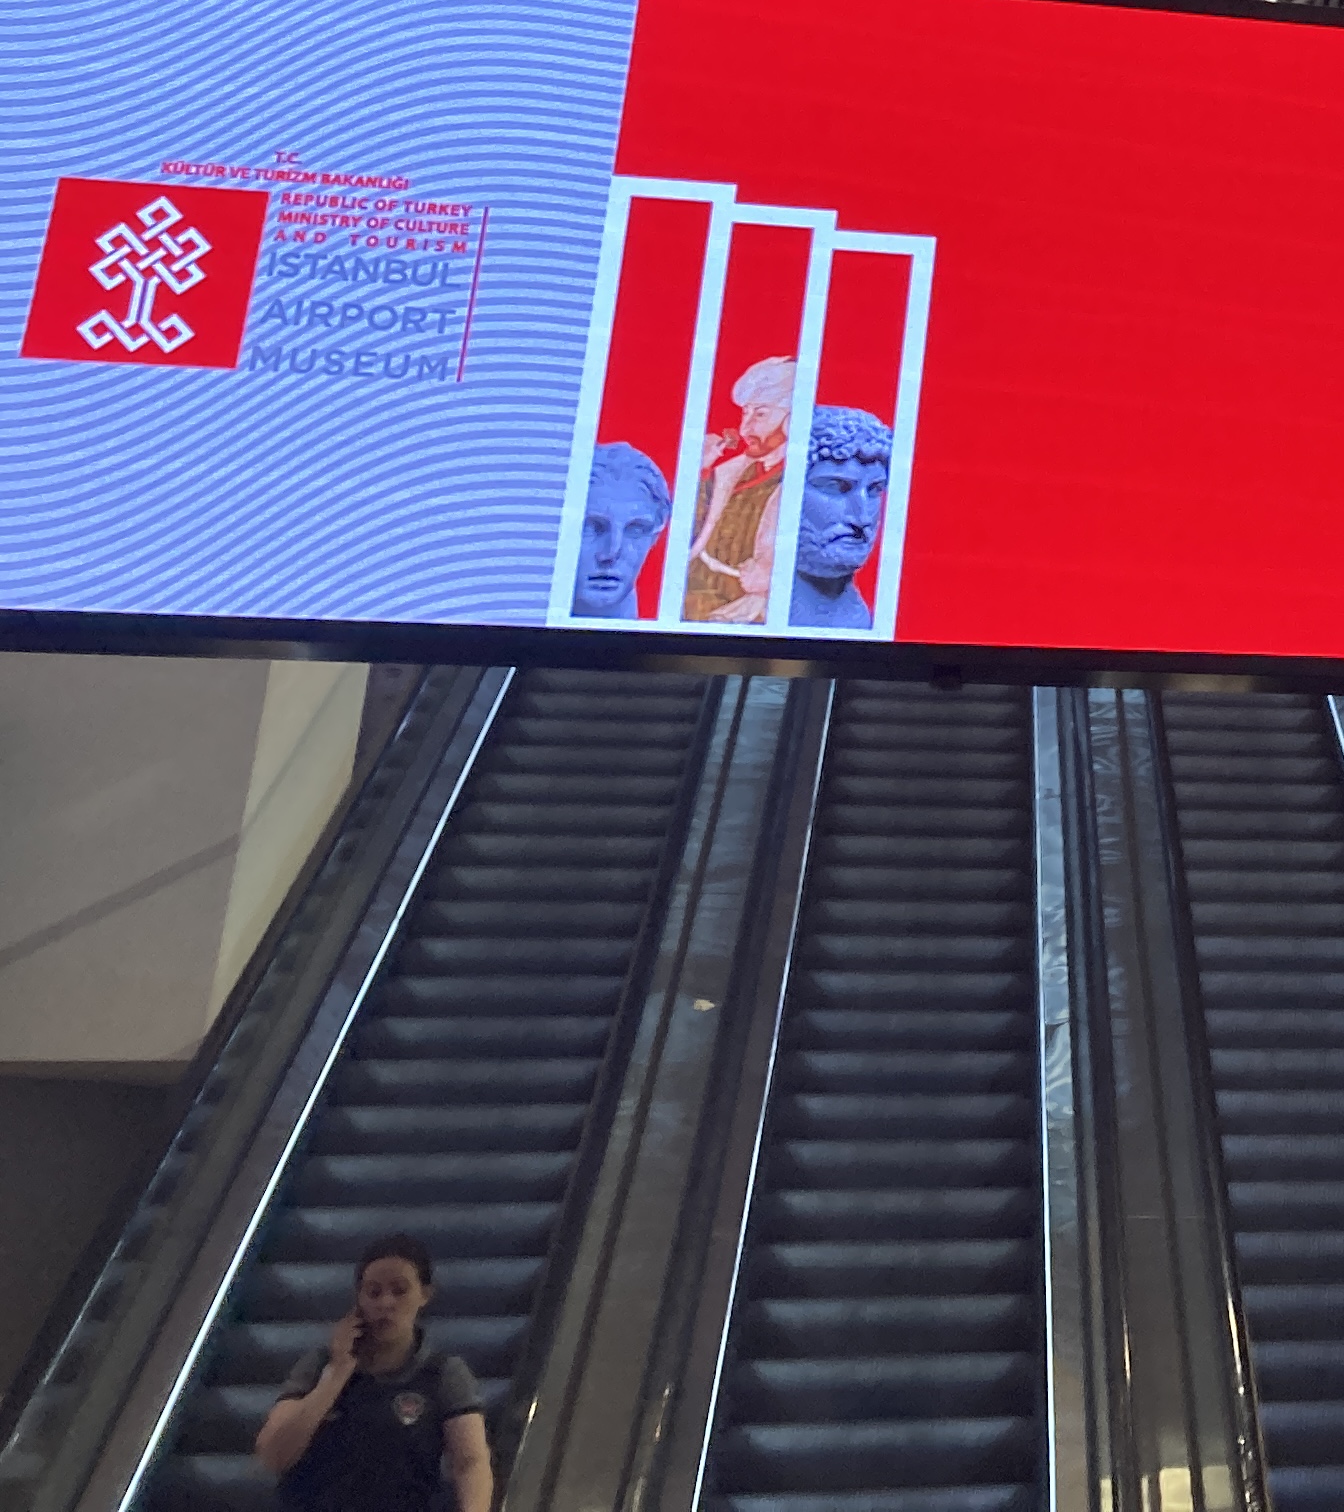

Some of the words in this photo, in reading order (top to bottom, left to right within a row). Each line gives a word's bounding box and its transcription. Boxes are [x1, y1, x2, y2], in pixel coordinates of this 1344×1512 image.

[229, 167, 251, 180] VE
[280, 192, 369, 211] REPUBLIC
[374, 199, 399, 213] OF
[403, 200, 473, 218] TURKEY
[276, 210, 362, 230] MINISTRY
[365, 217, 390, 231] OF
[393, 219, 470, 236] CULTURE
[273, 229, 328, 245] AND
[349, 233, 468, 255] TOURISM
[266, 250, 462, 289] ISTANBUL
[259, 298, 457, 335] AIRPORT
[247, 345, 450, 382] MUSEUM
